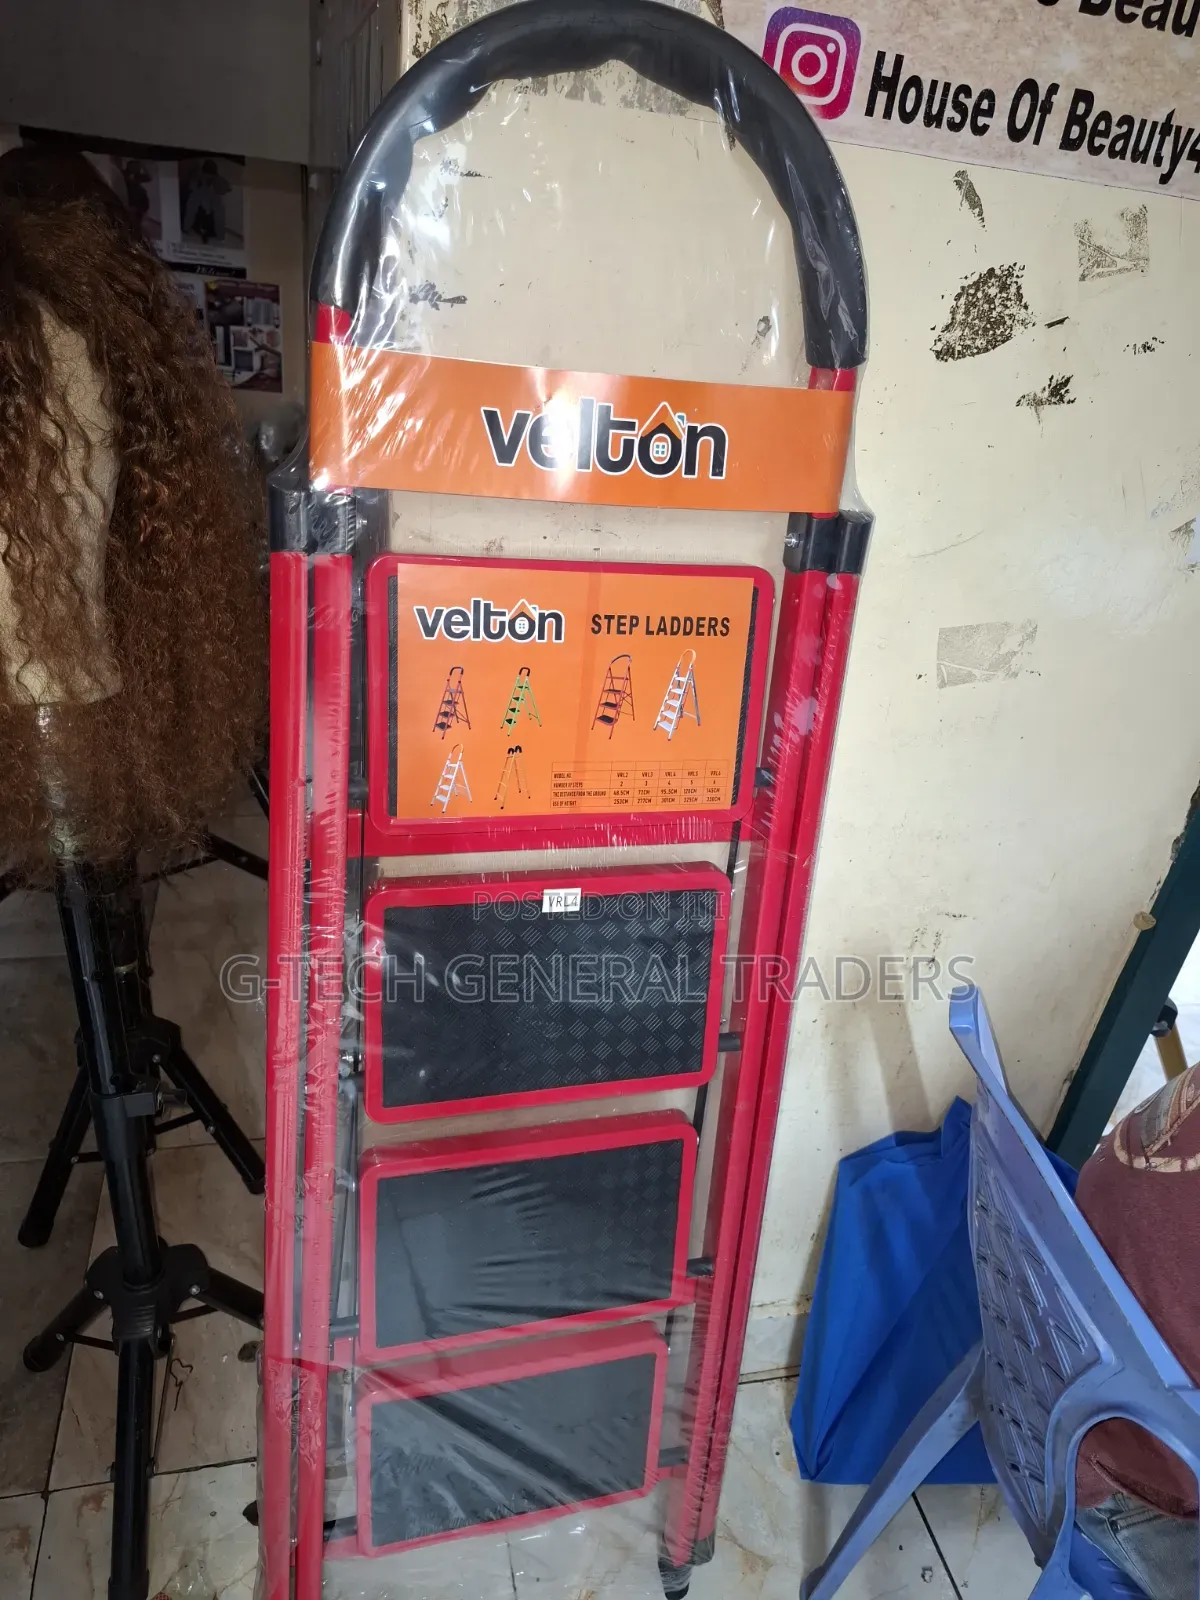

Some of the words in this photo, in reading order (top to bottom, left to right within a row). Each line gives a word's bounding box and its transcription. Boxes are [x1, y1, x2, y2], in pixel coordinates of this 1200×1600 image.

[864, 50, 996, 136] House
[1007, 78, 1060, 146] Of
[480, 396, 729, 480] velton
[414, 597, 565, 643] velton
[590, 613, 640, 636] STEP
[645, 615, 730, 637] LADDERS
[548, 895, 578, 908] VRL4
